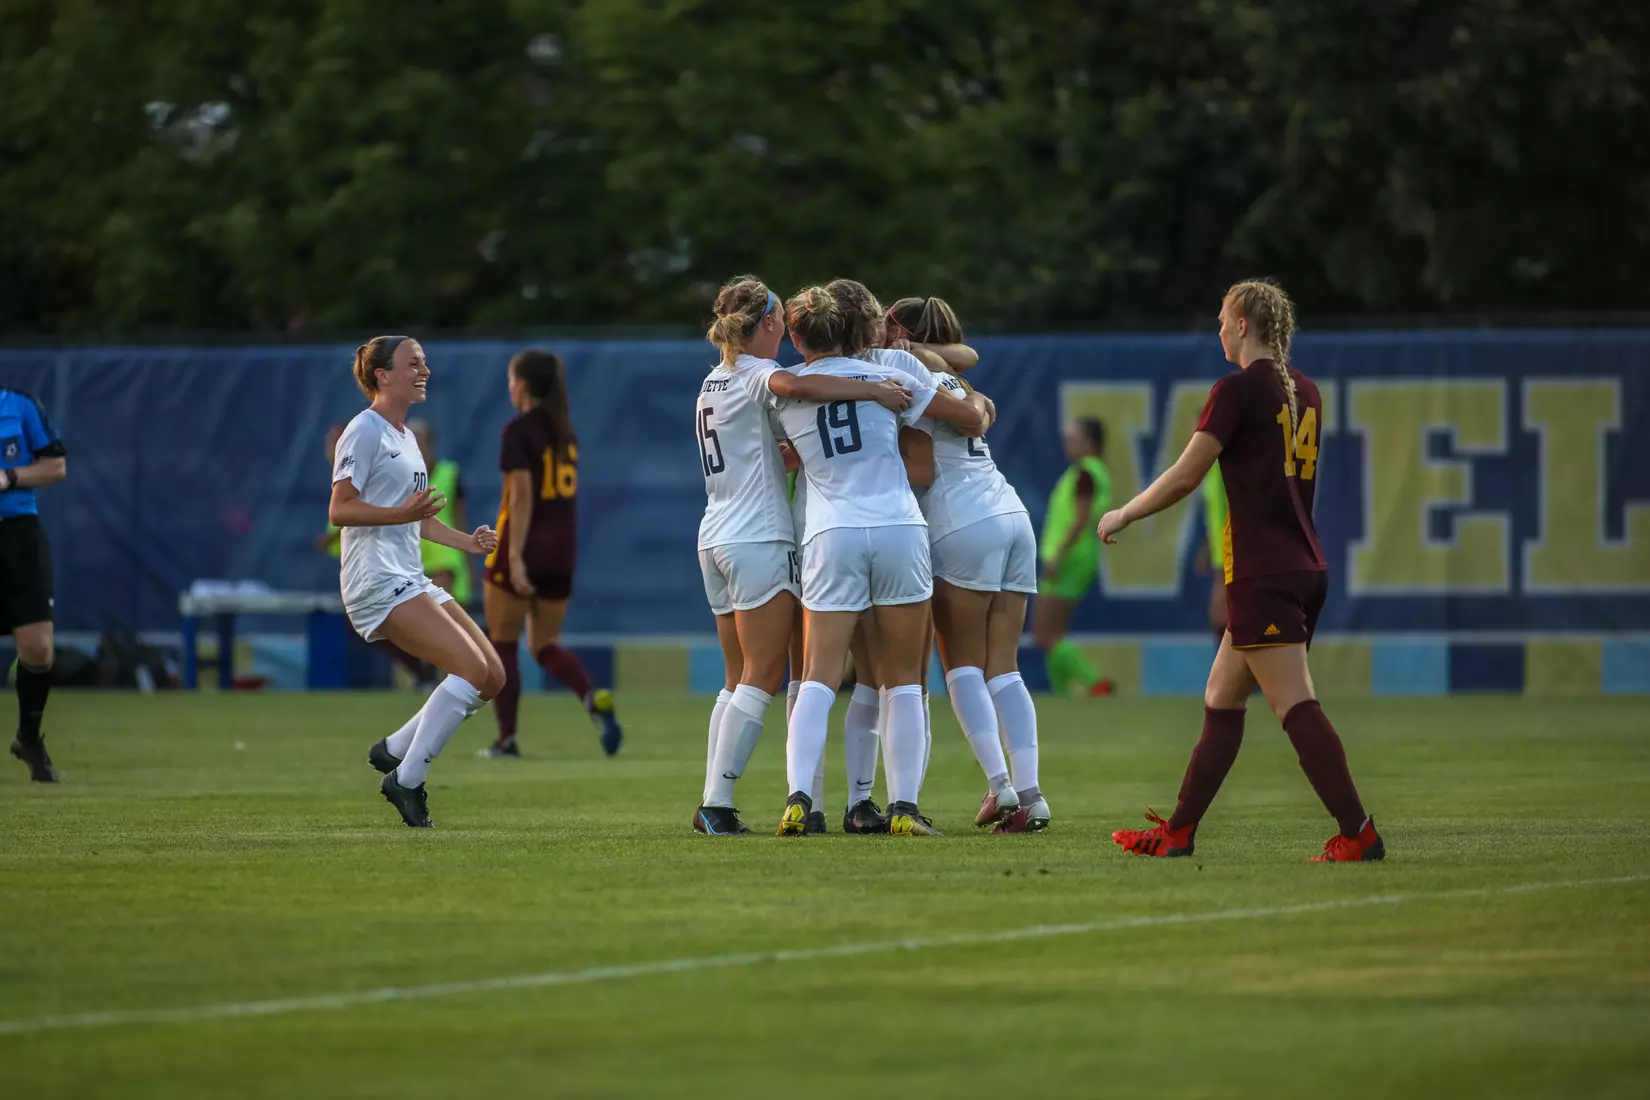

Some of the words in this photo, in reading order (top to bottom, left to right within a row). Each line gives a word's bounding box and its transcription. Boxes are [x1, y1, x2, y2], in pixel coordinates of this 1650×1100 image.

[698, 407, 725, 477] 15
[816, 399, 862, 459] 19
[1276, 403, 1318, 480] 14
[540, 444, 578, 500] 16
